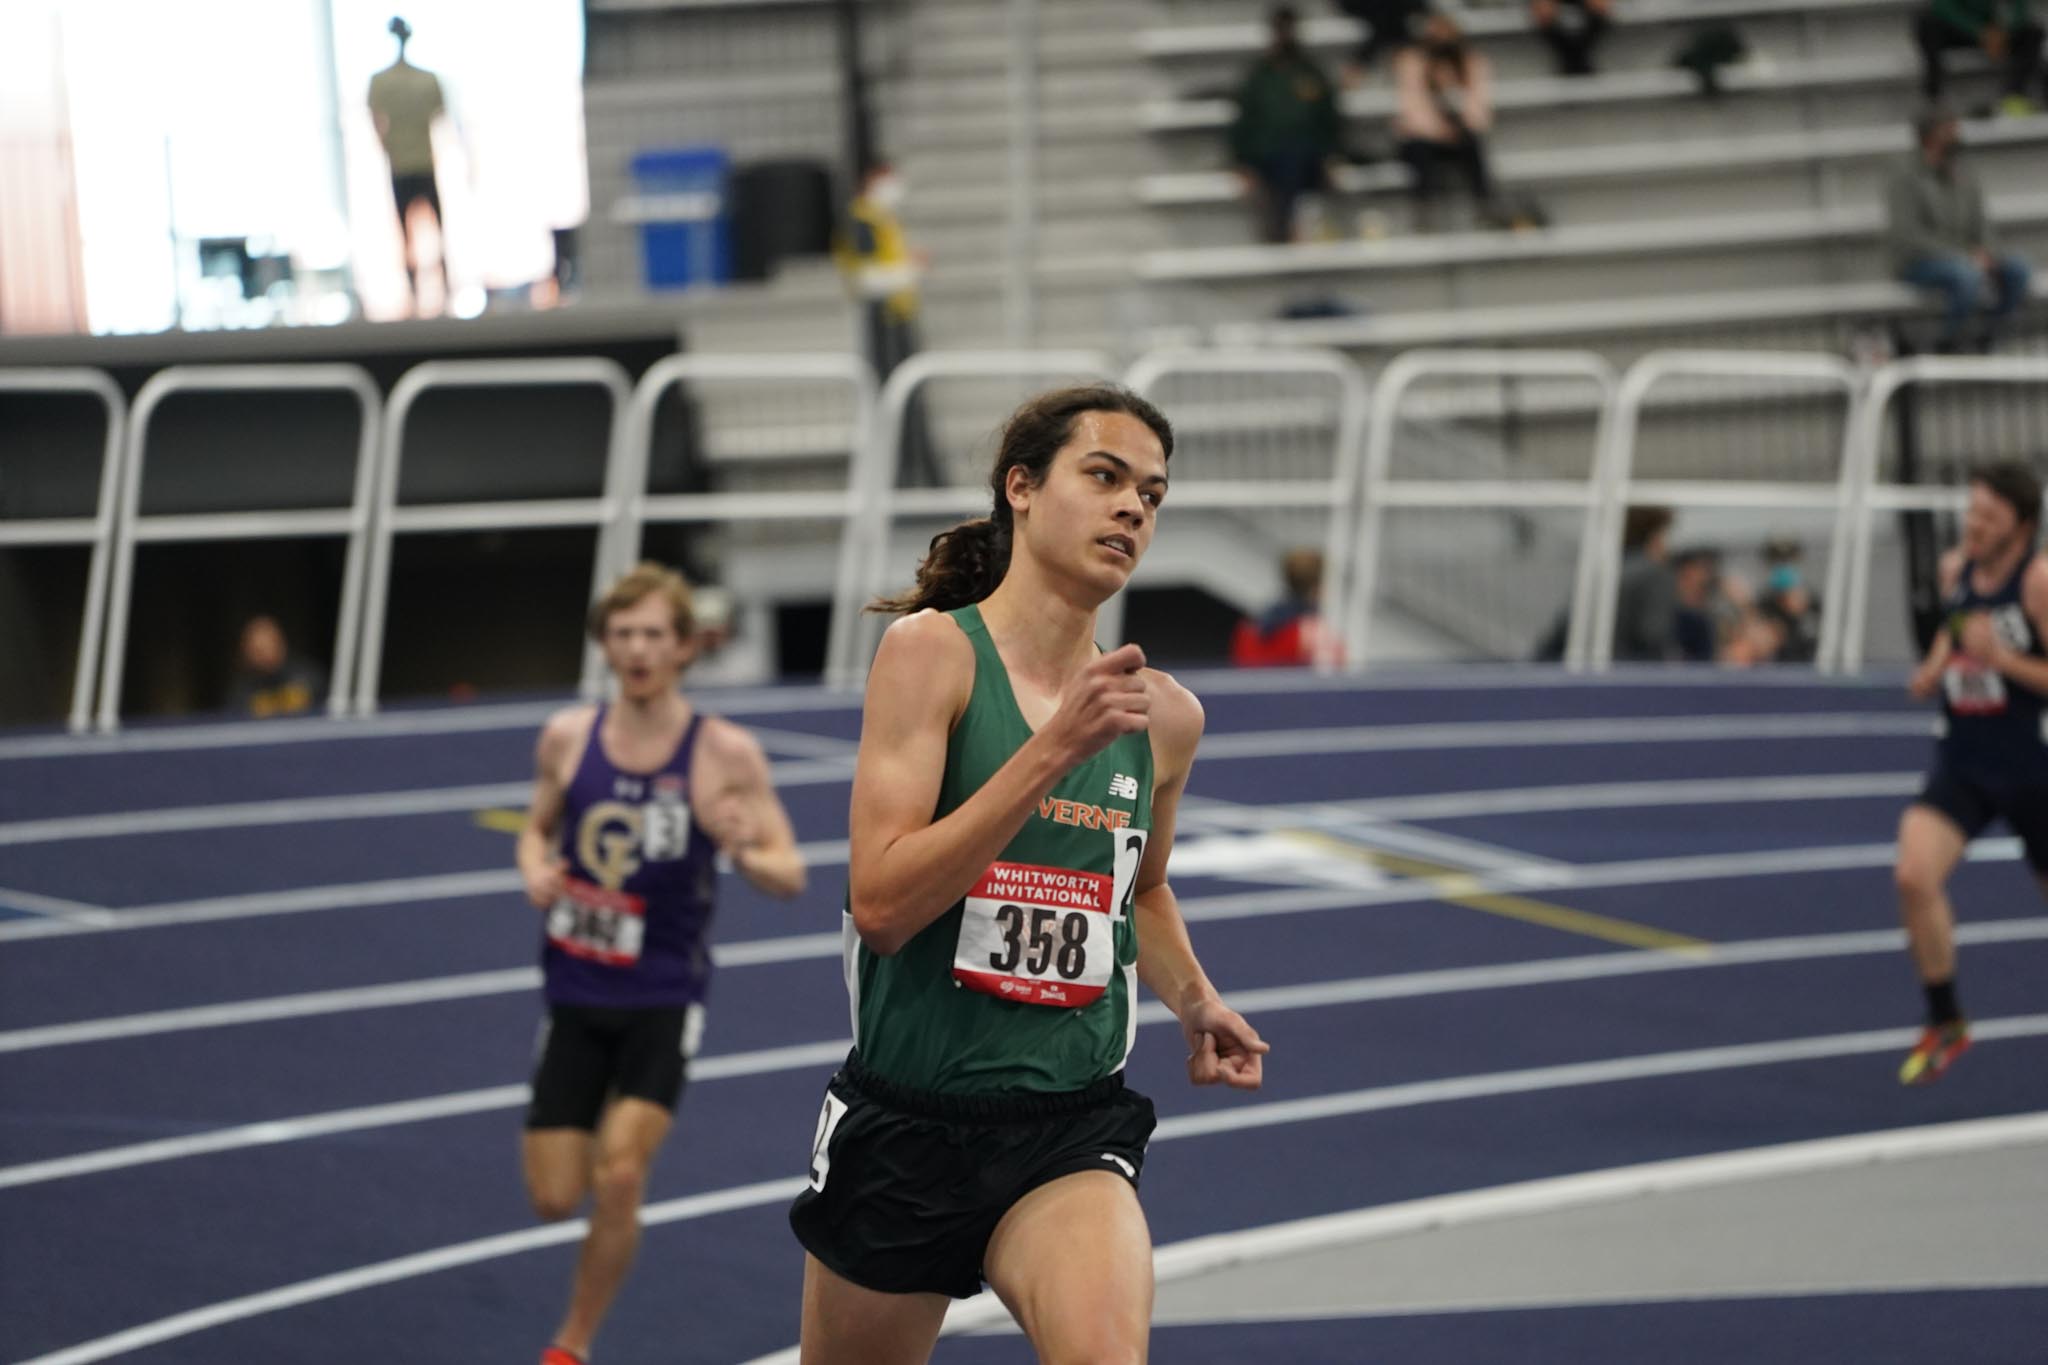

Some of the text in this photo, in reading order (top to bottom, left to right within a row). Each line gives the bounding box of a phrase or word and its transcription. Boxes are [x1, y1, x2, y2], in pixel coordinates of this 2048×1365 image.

[1039, 796, 1131, 831] VERNE
[994, 867, 1099, 892] WHITWORTH
[1120, 836, 1142, 916] 2
[987, 882, 1100, 907] INVITATIONAL
[990, 904, 1089, 979] 358
